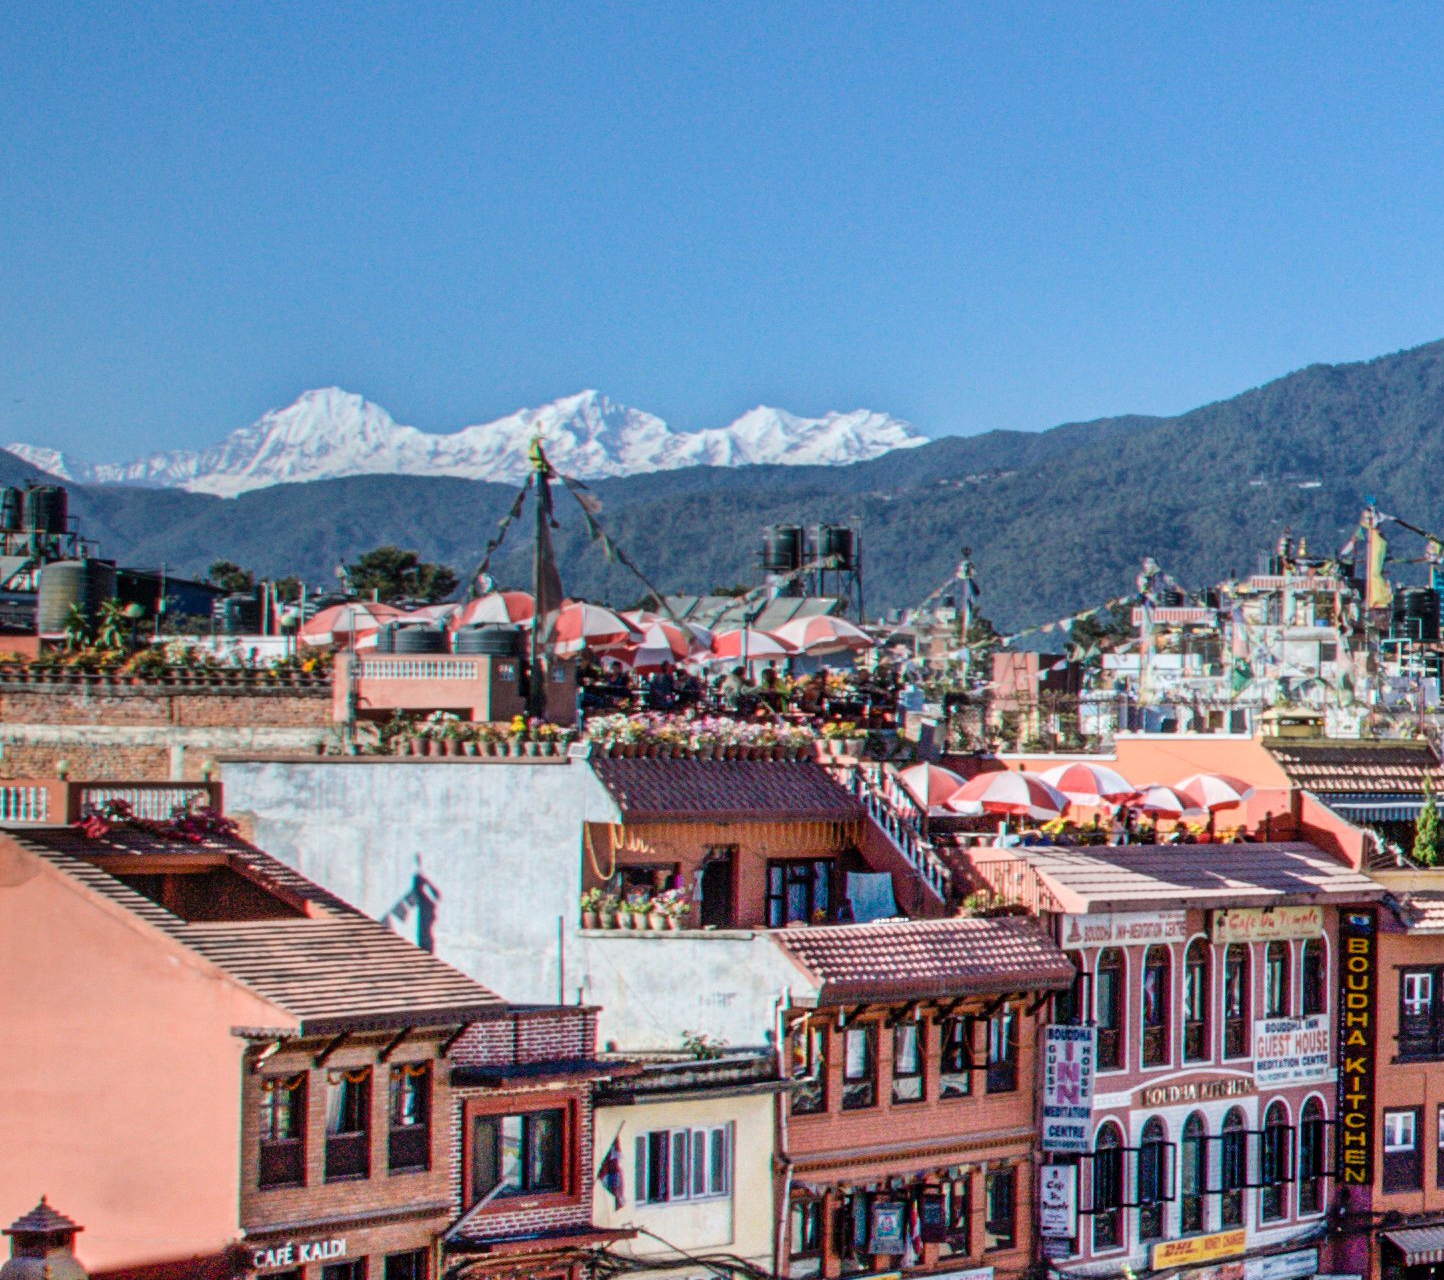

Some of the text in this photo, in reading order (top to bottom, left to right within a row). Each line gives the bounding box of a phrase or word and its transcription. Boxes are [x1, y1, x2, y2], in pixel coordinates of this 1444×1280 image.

[1047, 1028, 1092, 1041] BOUDDHA
[1258, 1030, 1328, 1058] GUEST HOUSE
[1047, 1045, 1056, 1095] GUEST
[1057, 1042, 1079, 1104] INN
[1081, 1046, 1091, 1097] HOUSE
[1257, 1054, 1328, 1070] MEDITATION CENTRE
[1344, 938, 1369, 1182] BOUDHA KITCHEN
[1044, 1106, 1091, 1118] MEDITATION
[1048, 1125, 1085, 1139] CENTRE
[254, 1239, 347, 1268] CAFÉ KALDI
[1164, 1240, 1194, 1257] DHL
